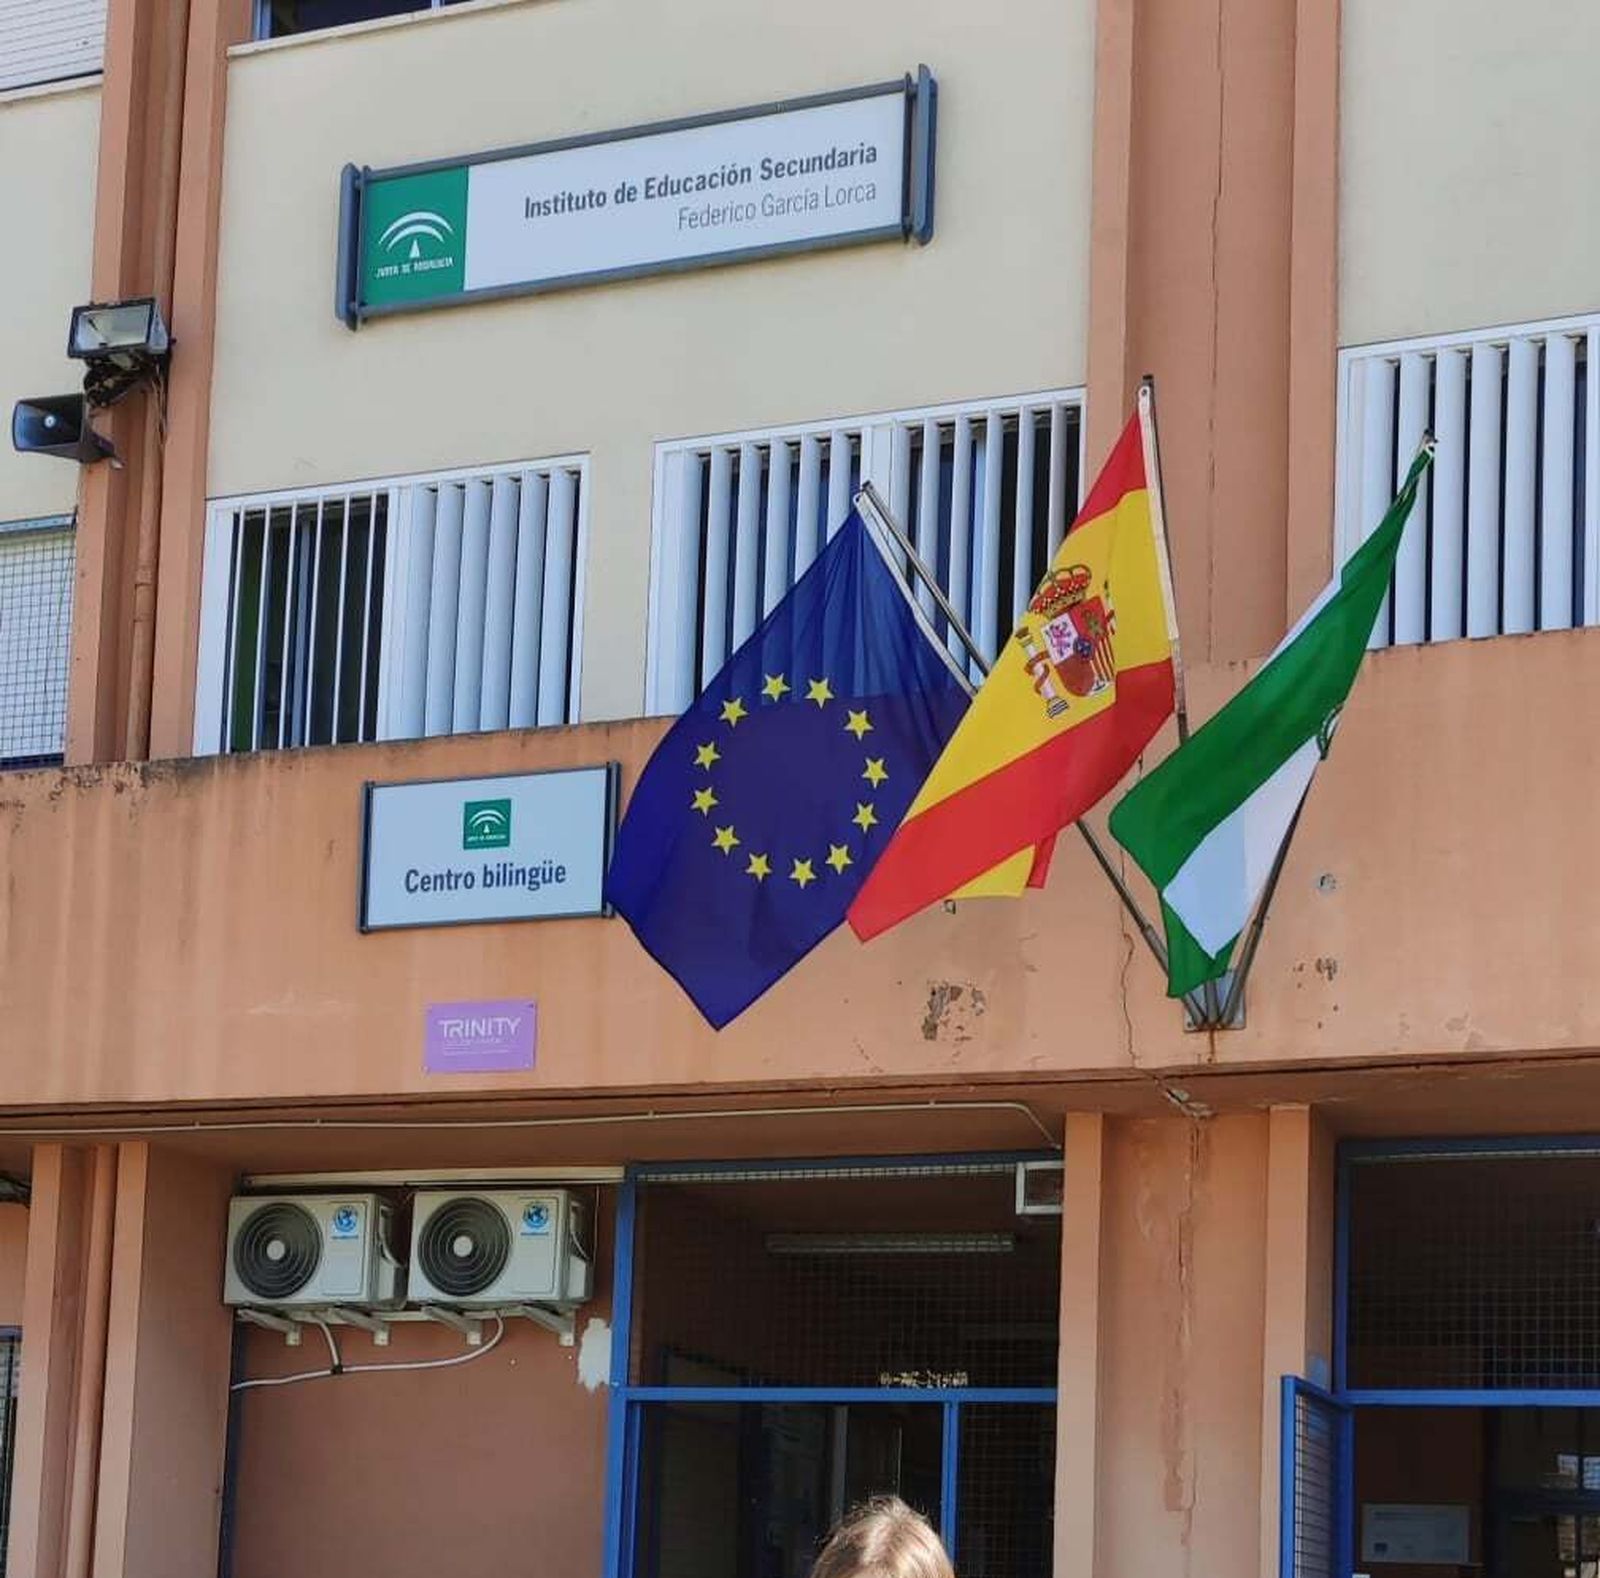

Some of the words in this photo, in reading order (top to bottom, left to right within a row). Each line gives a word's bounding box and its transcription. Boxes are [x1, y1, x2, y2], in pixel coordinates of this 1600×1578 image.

[524, 188, 608, 219] Instituto
[613, 180, 639, 205] de
[644, 163, 752, 200] Educación
[759, 142, 878, 182] Secundaria
[678, 202, 758, 231] Federico
[761, 190, 821, 221] García
[824, 180, 877, 211] Lorca
[404, 867, 476, 895] Centro
[482, 859, 567, 891] bilingüe
[439, 1017, 521, 1038] TRINITY
